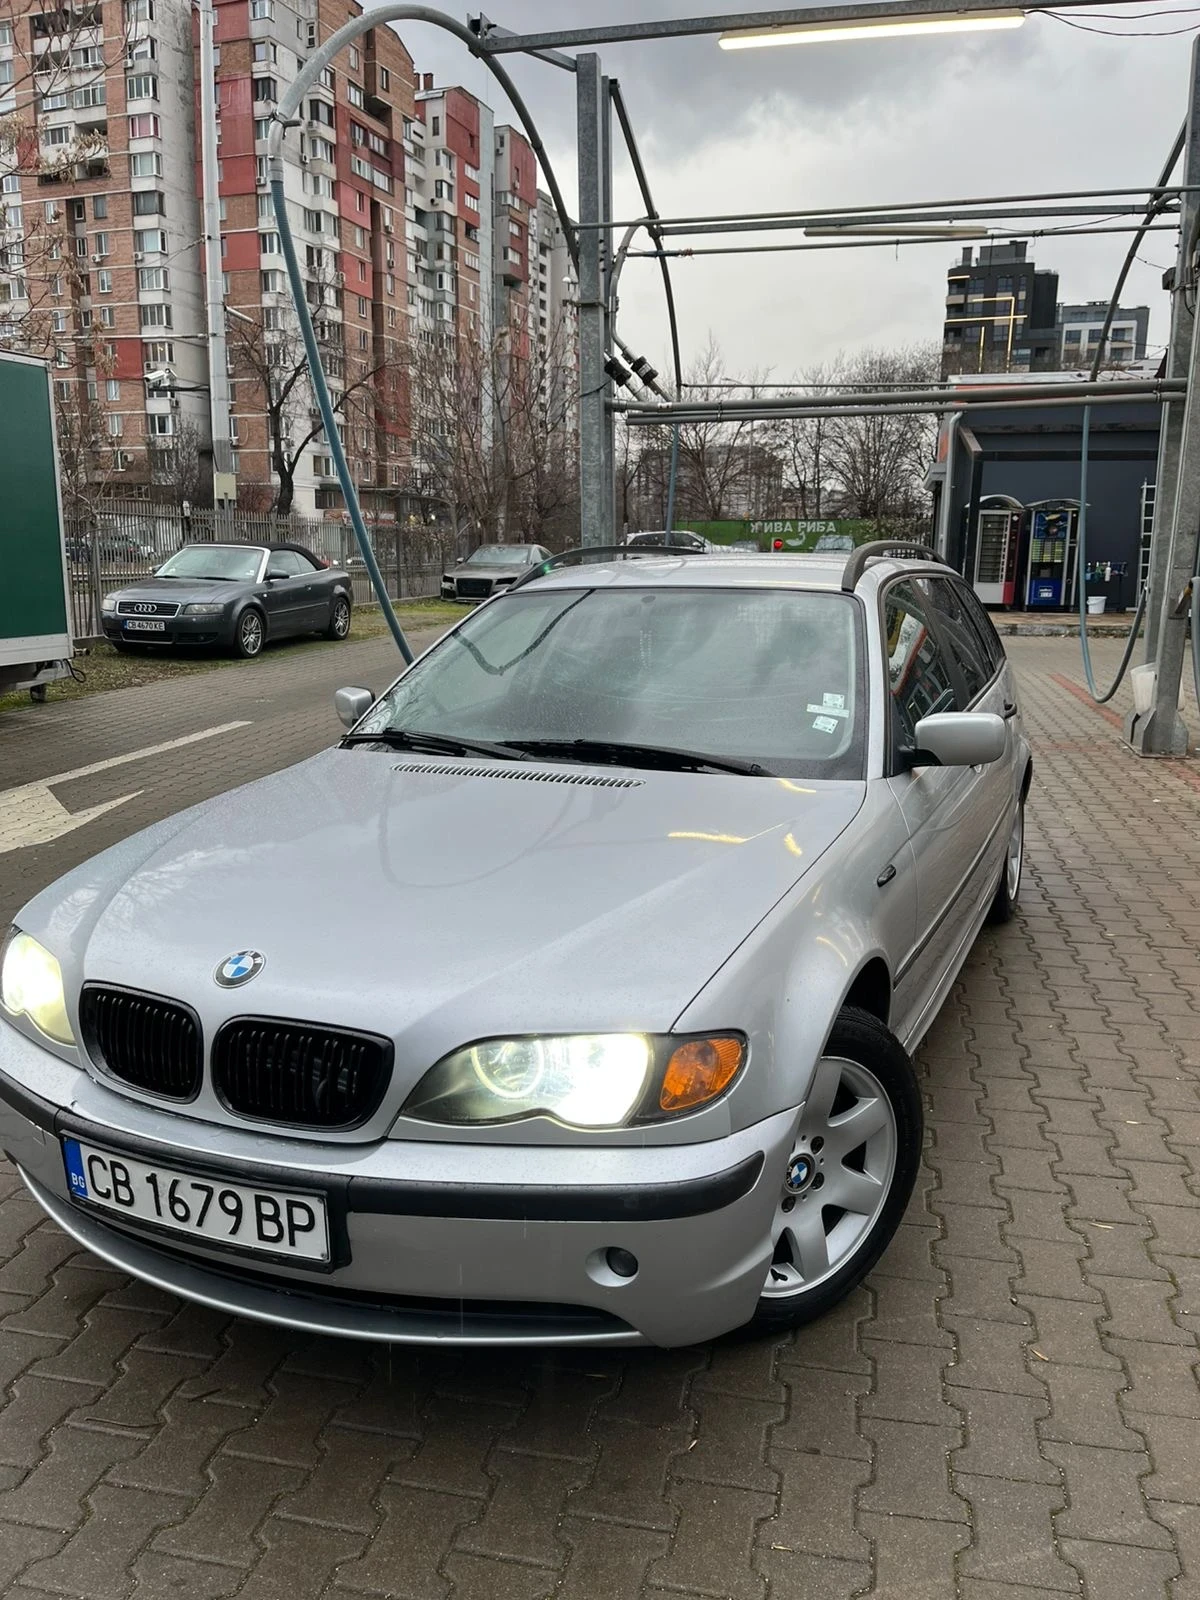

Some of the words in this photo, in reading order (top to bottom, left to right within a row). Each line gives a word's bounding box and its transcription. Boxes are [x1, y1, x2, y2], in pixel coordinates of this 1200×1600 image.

[750, 521, 793, 533] ЖИВА
[798, 521, 836, 533] РИБА
[71, 1172, 85, 1188] BG
[87, 1154, 135, 1207] CB
[146, 1172, 243, 1235] 1679
[254, 1194, 316, 1247] BP
